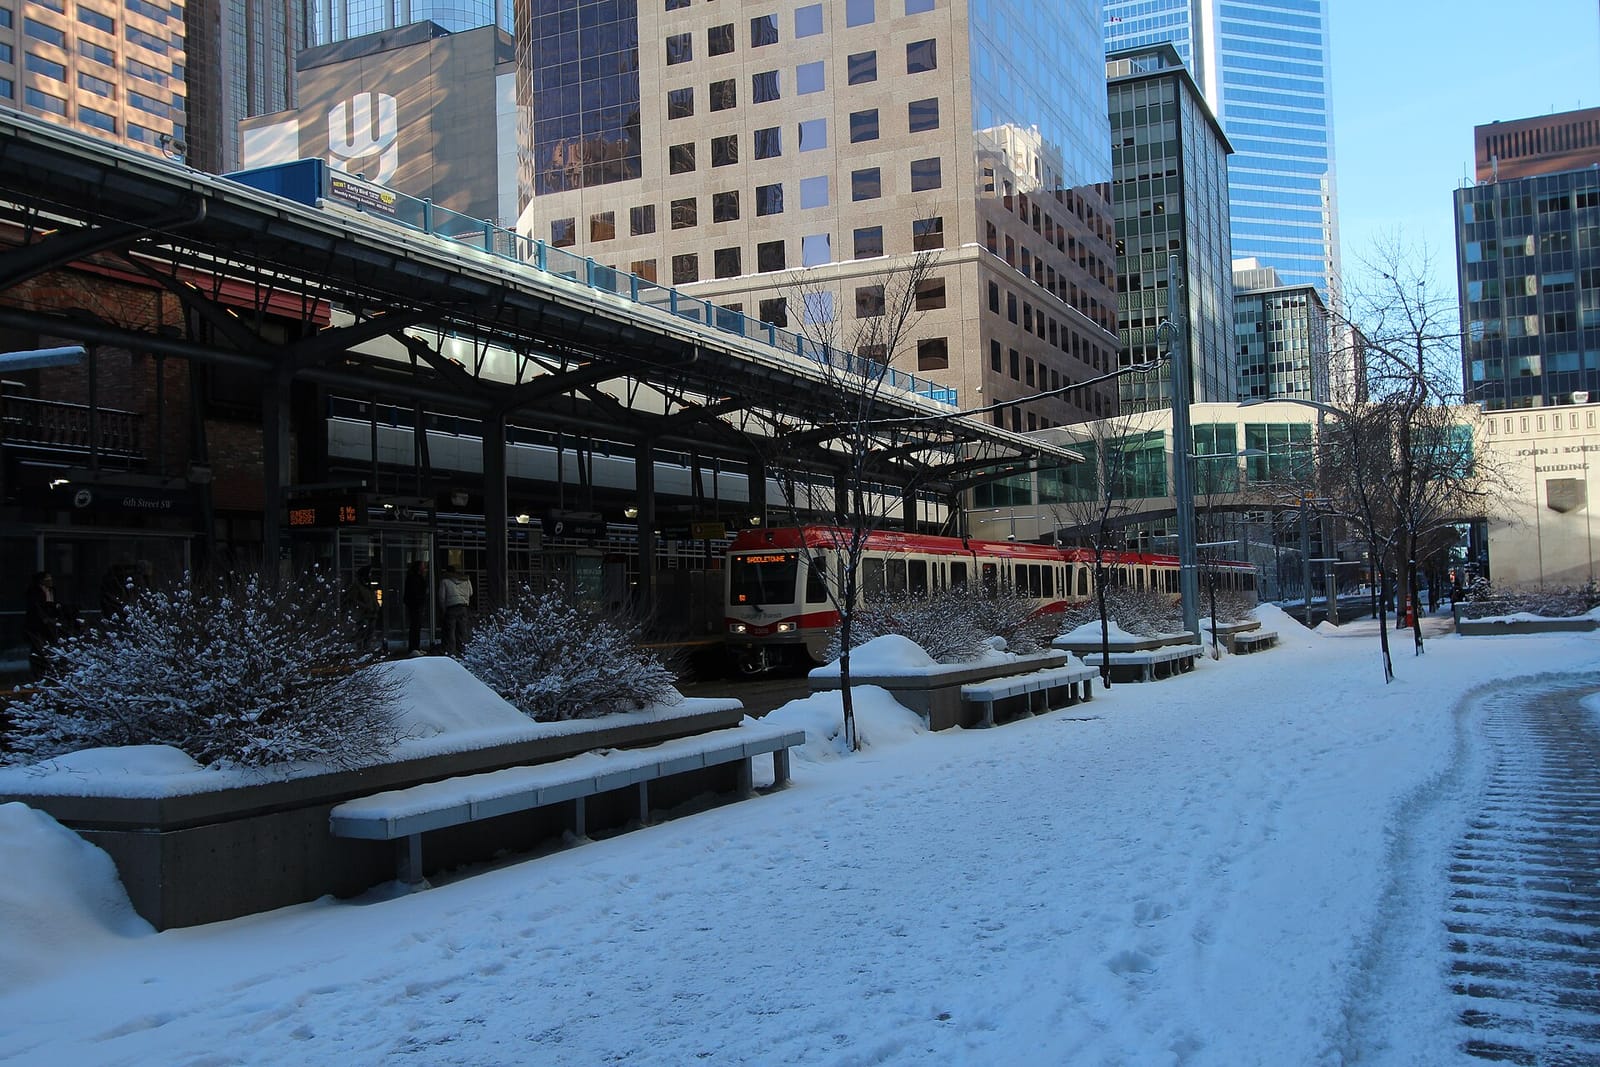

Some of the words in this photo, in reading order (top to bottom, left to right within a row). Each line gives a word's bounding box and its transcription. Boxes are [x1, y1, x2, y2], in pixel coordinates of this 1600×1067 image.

[347, 184, 358, 193] Early
[359, 188, 369, 196] Bird
[1516, 448, 1548, 456] JOHN
[1535, 463, 1590, 472] BUILDING
[122, 497, 136, 507] 6th
[137, 498, 159, 509] Street
